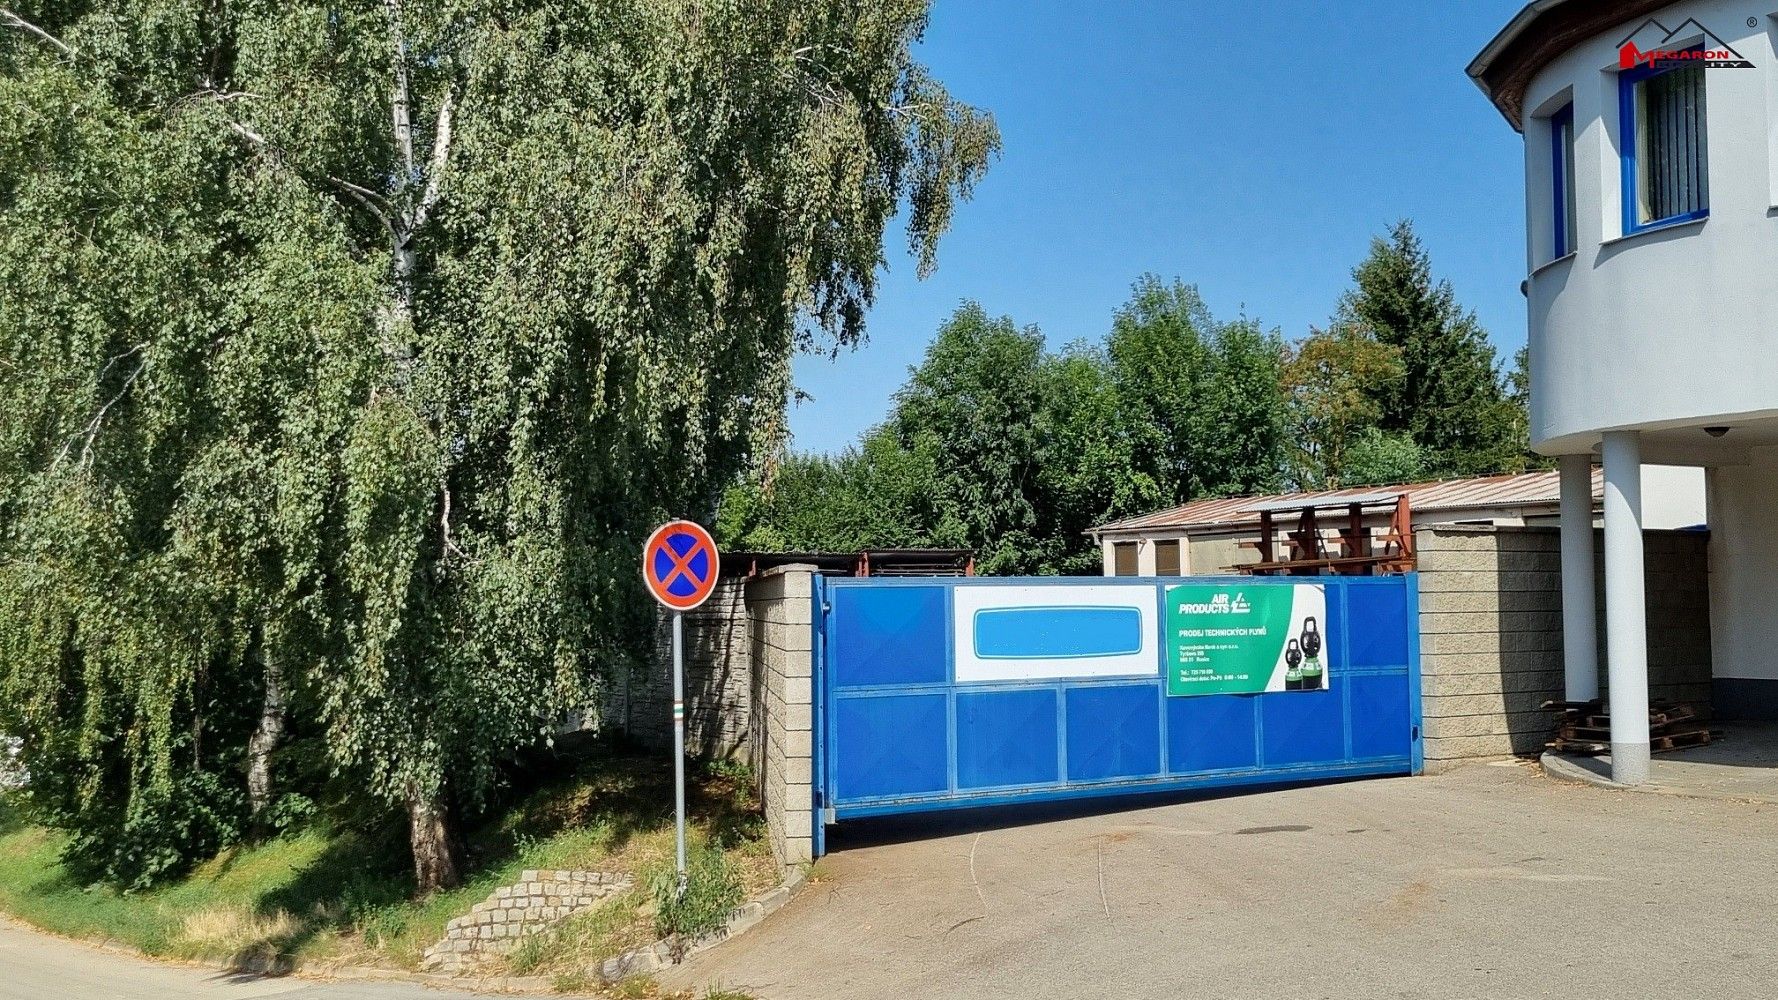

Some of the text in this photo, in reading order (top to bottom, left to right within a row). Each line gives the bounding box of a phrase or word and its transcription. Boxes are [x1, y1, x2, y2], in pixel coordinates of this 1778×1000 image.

[1211, 594, 1229, 604] AIR
[1178, 604, 1230, 614] PRODUCTS
[1178, 625, 1267, 637] PRODEJ TECHNICKÝCH PLYNŮ
